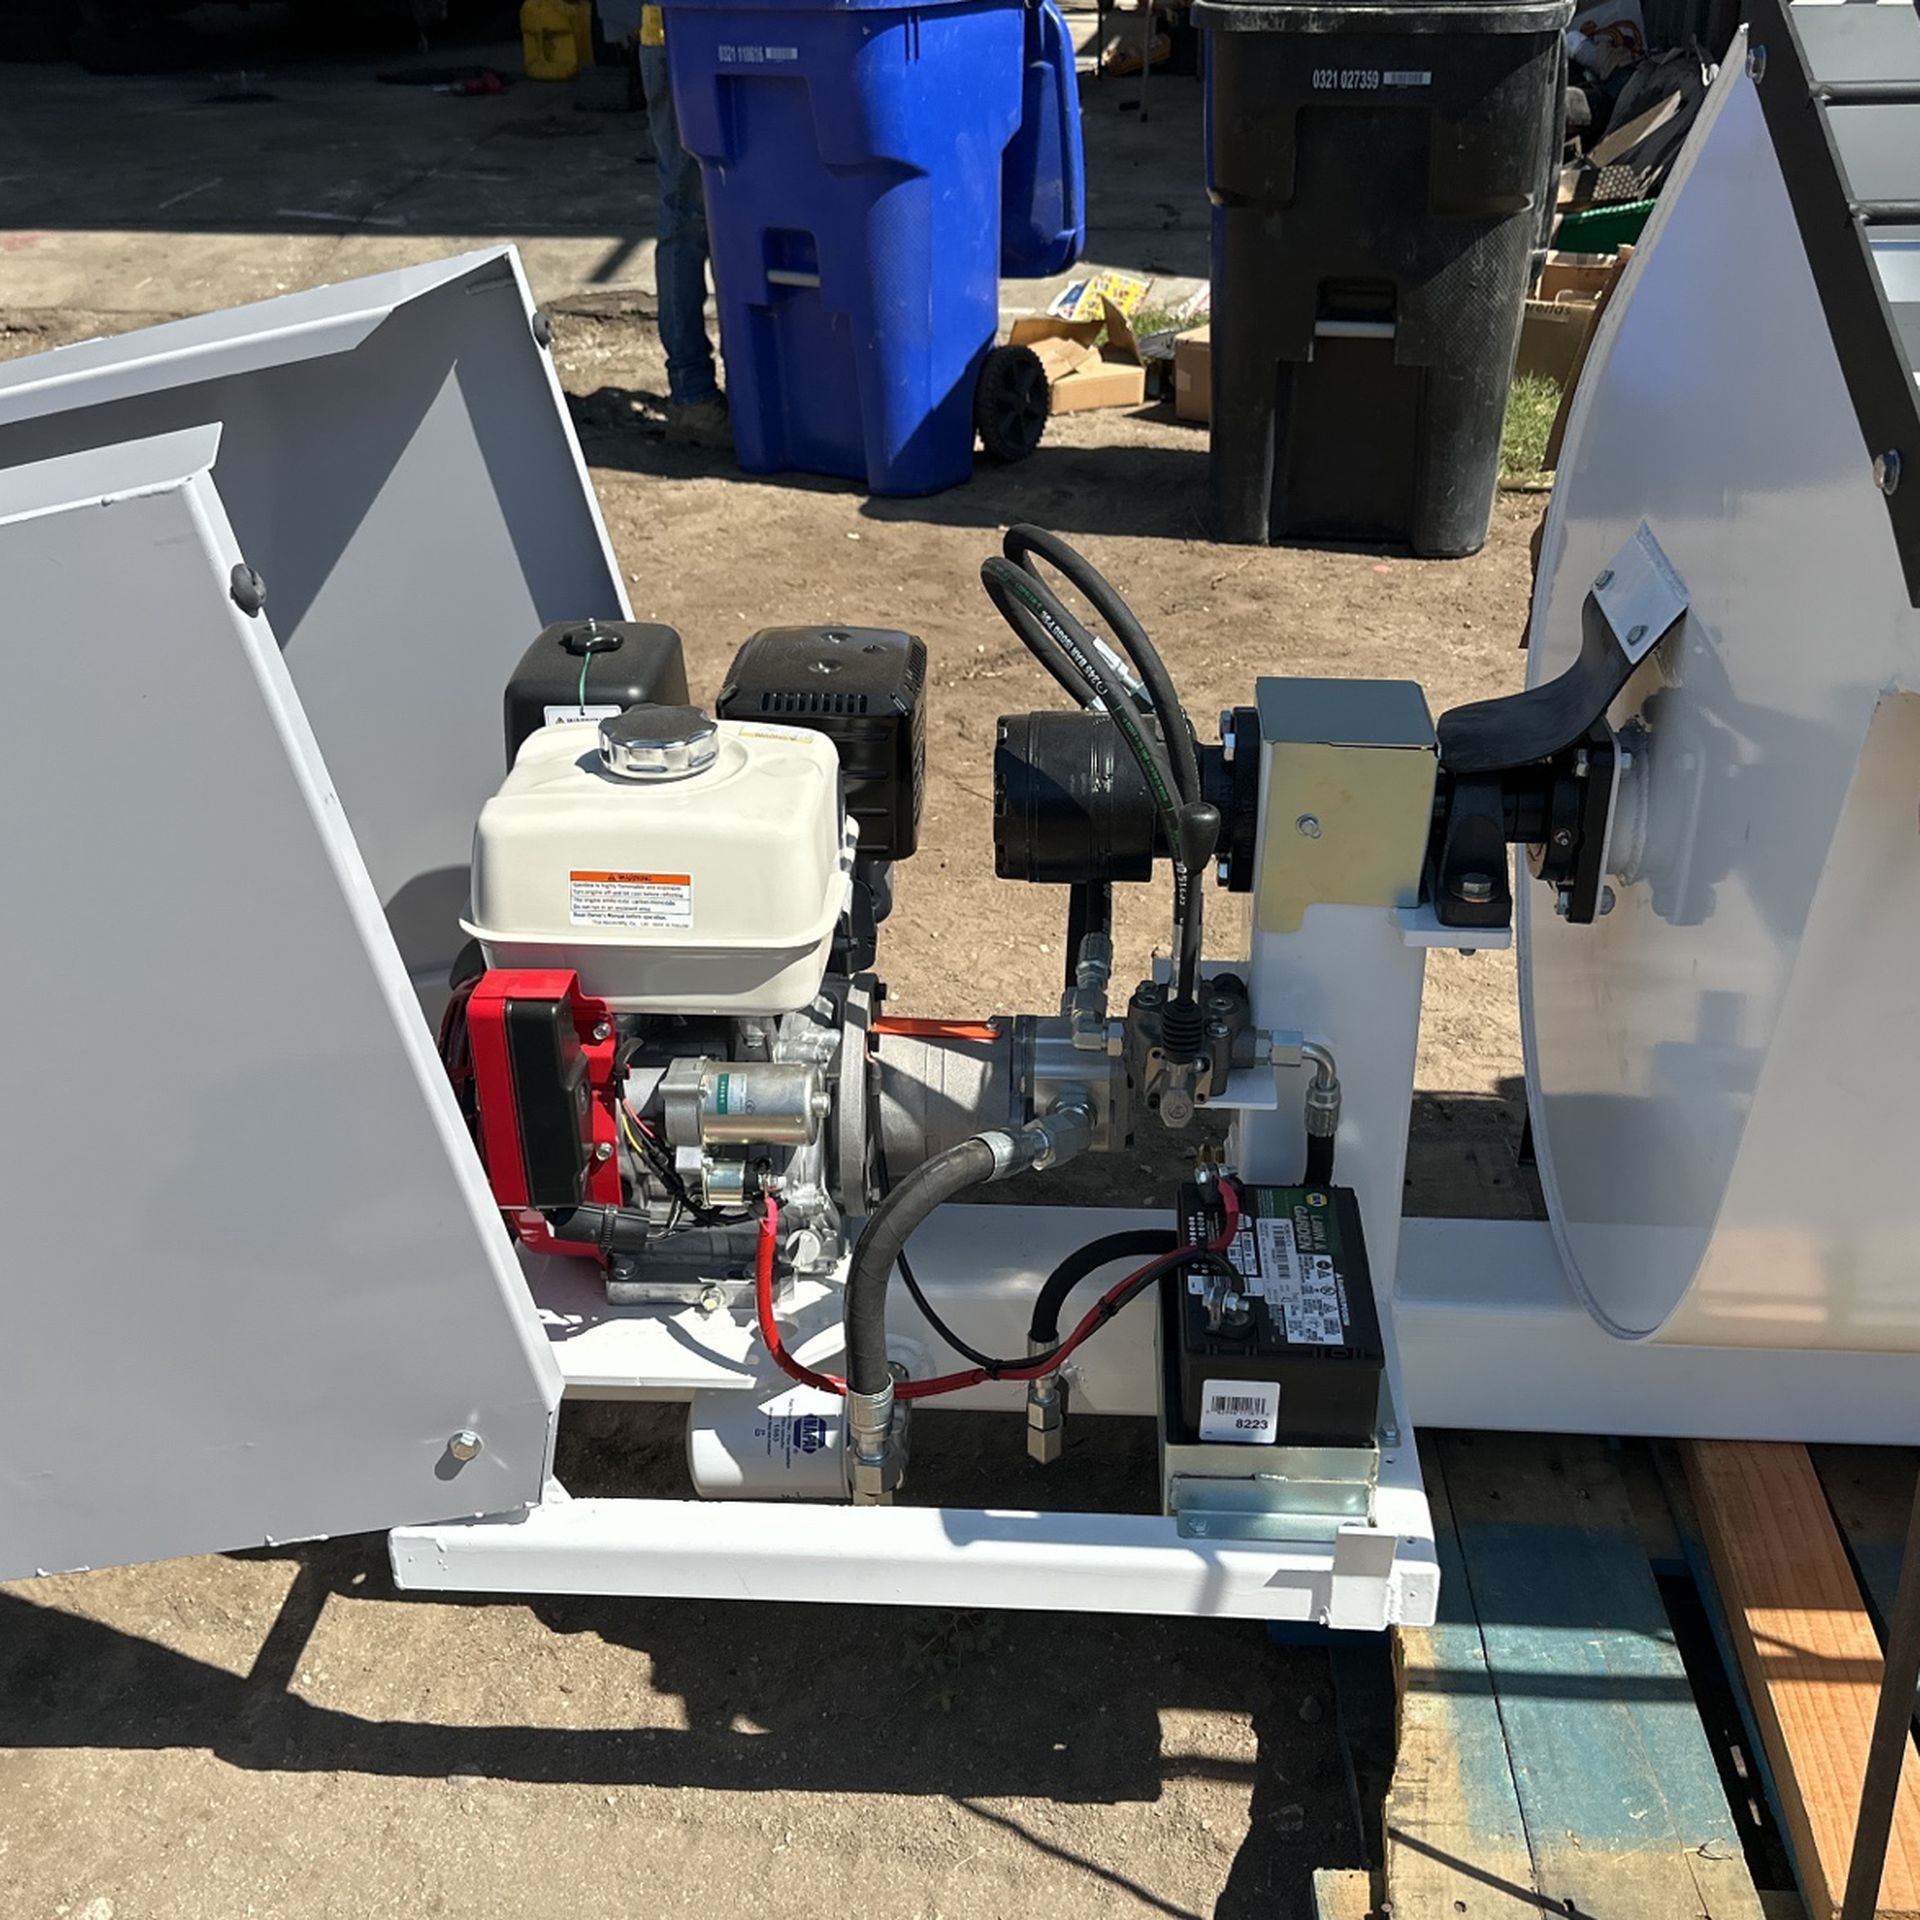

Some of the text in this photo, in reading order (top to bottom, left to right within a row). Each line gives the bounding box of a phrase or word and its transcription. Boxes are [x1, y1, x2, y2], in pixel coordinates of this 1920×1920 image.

[1312, 69, 1379, 89] 0321 027359
[1294, 1206, 1313, 1250] GARDEN
[802, 1420, 818, 1450] NAPA
[1236, 1419, 1269, 1430] 8223
